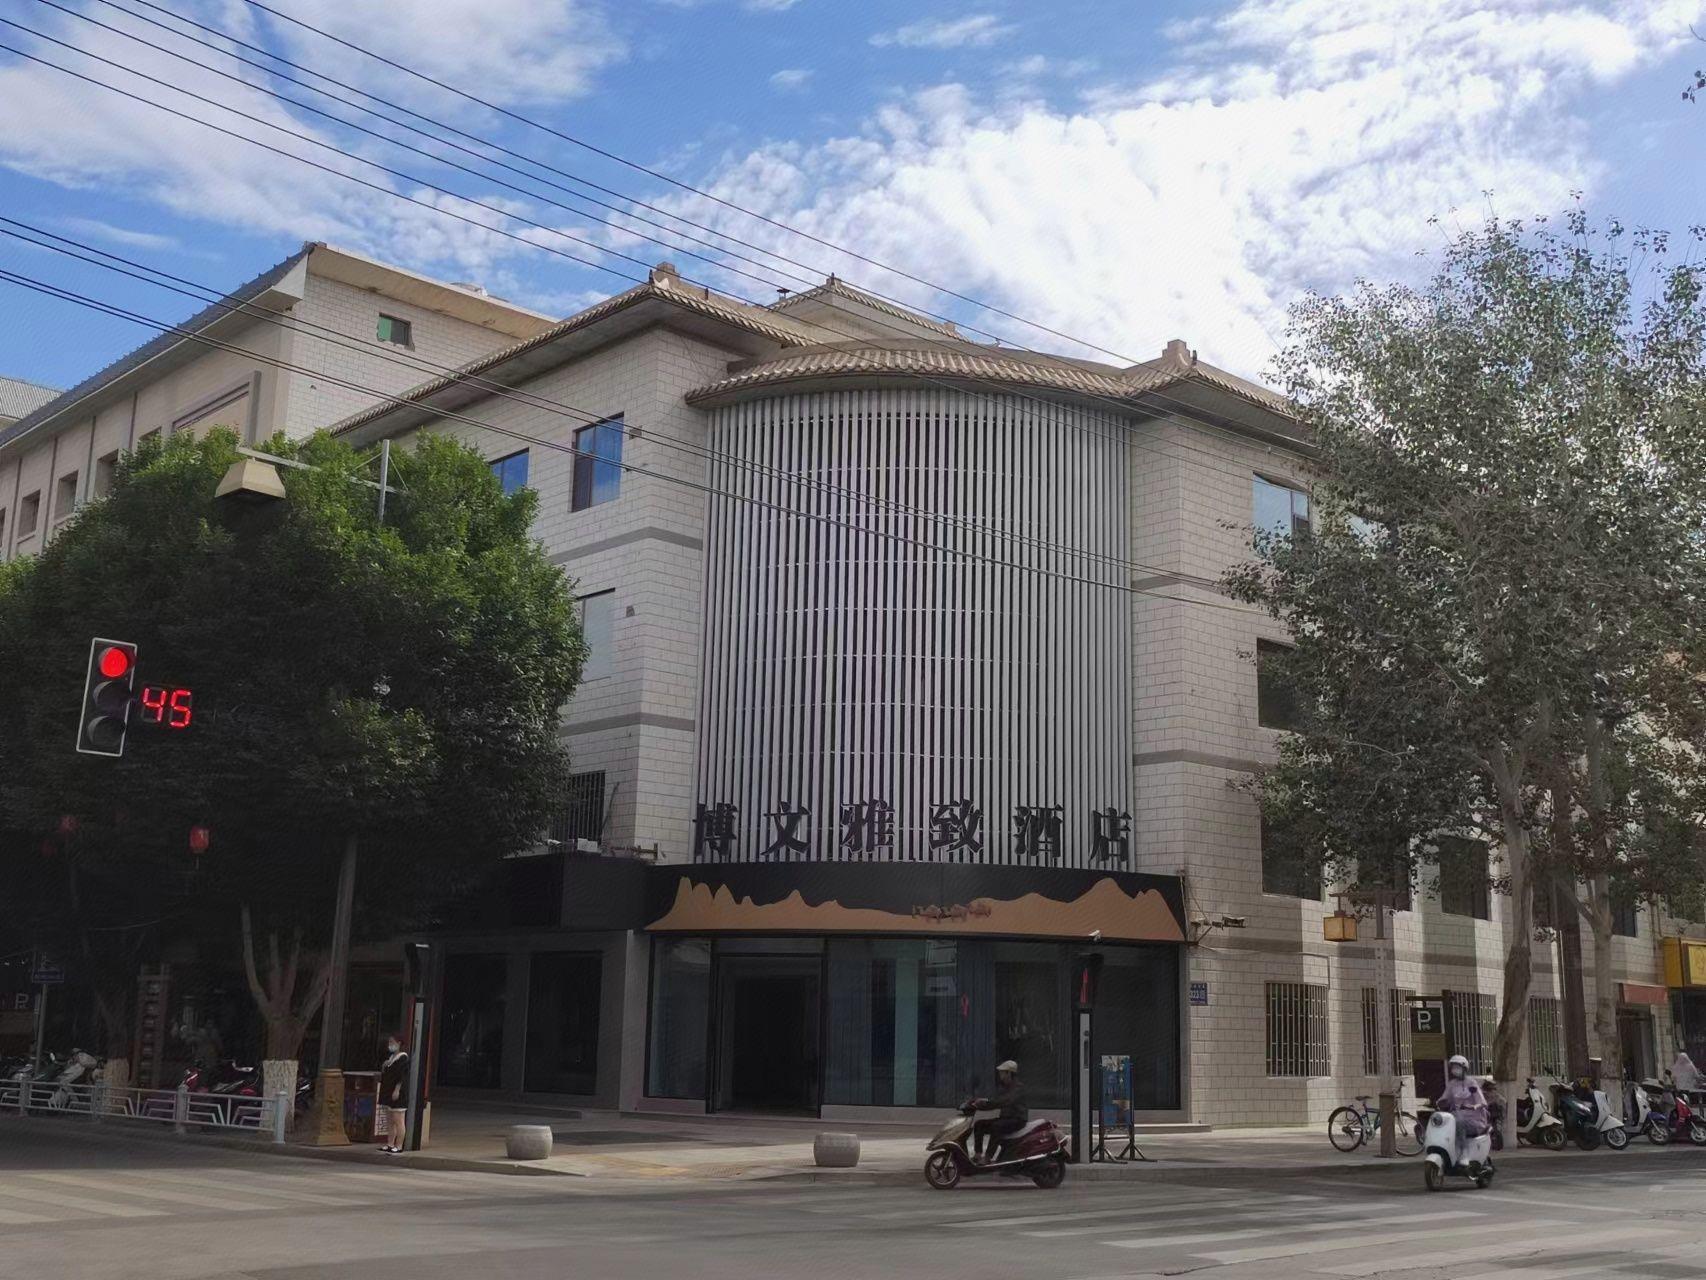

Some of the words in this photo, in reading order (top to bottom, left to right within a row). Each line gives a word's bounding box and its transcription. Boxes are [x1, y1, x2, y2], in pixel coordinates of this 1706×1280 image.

[142, 687, 193, 727] 45
[692, 798, 1132, 862] 博文雅致酒店
